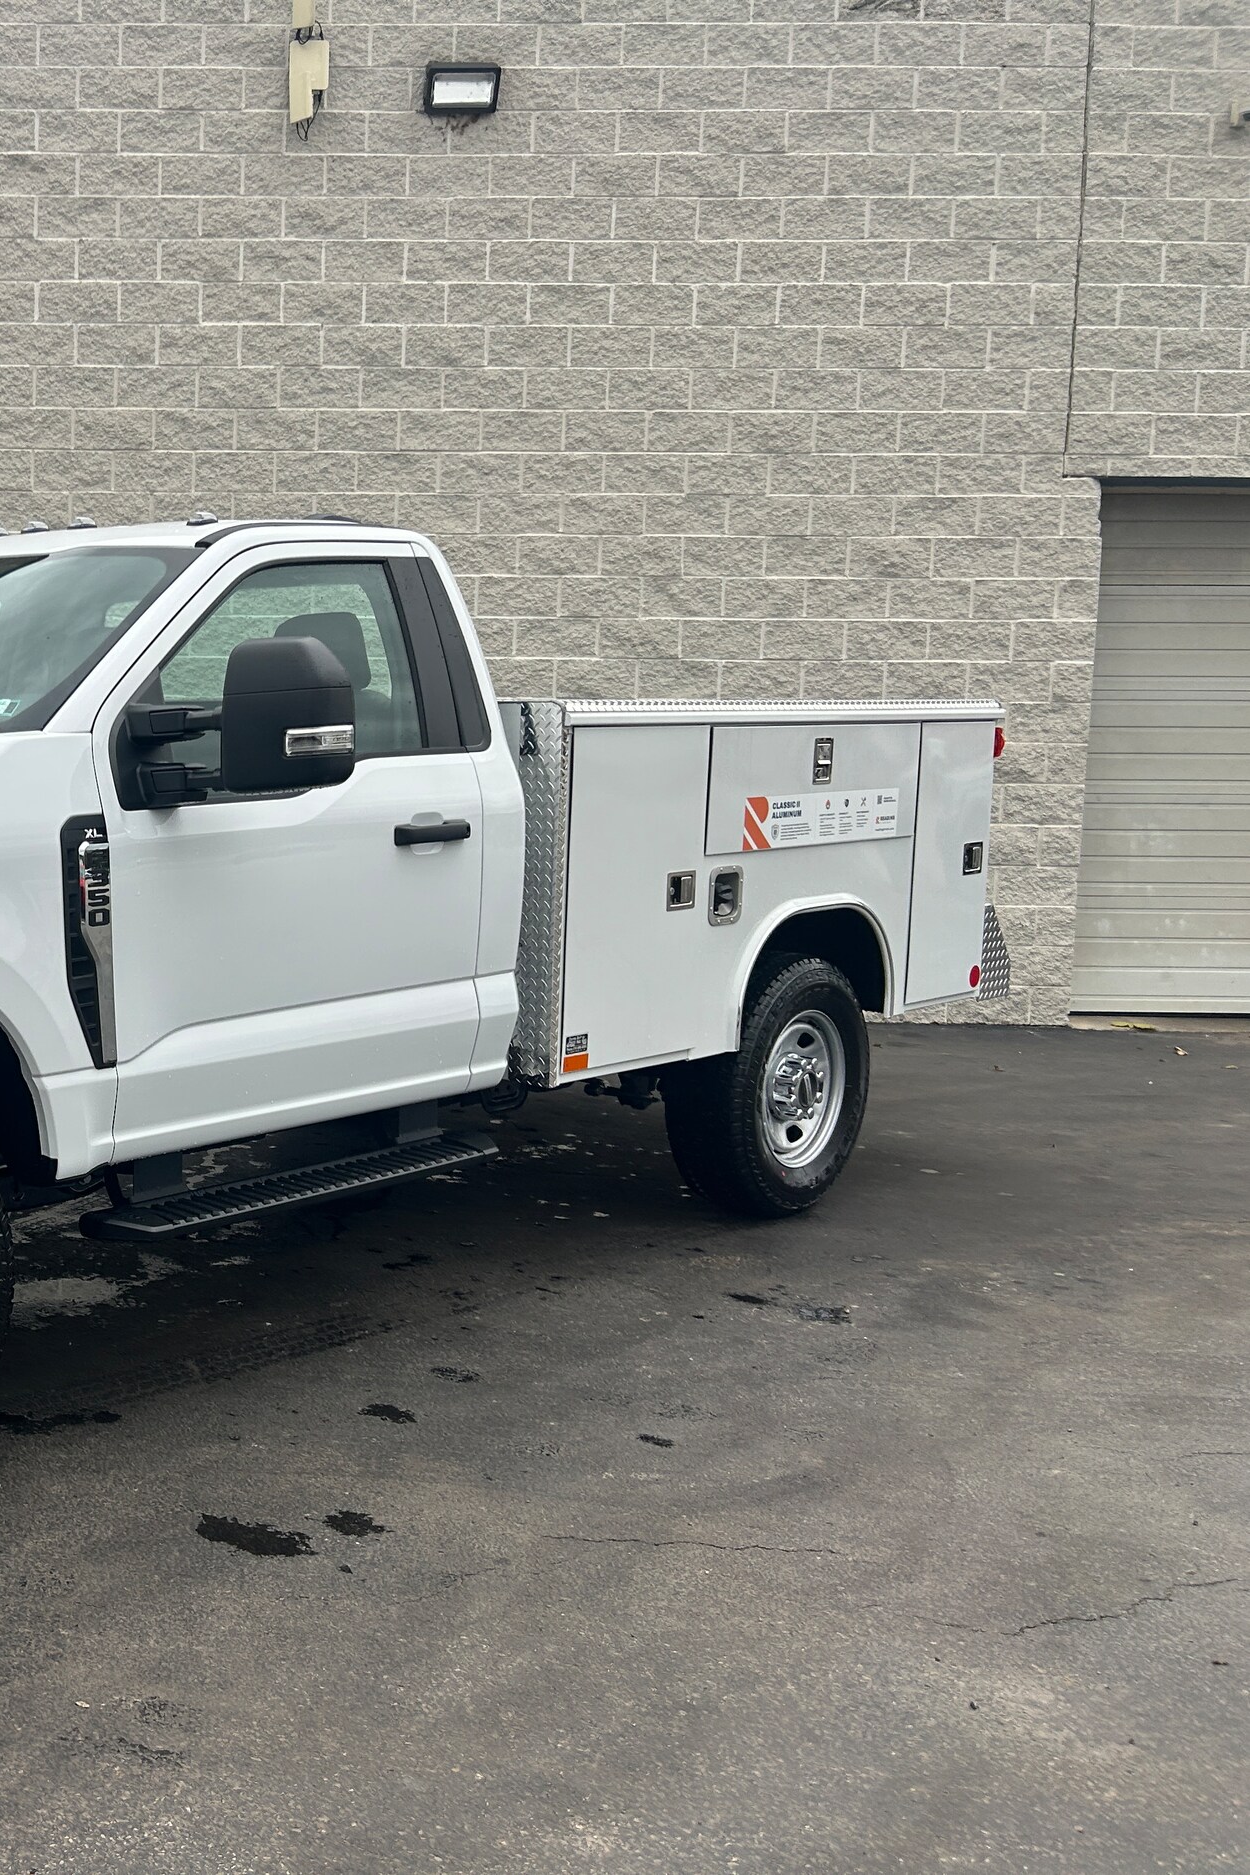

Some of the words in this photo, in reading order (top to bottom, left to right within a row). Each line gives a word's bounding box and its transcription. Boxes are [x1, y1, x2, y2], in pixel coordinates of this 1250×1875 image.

[772, 801, 796, 810] CLASSIC
[771, 810, 802, 819] ALUMINUM
[84, 828, 103, 839] XL
